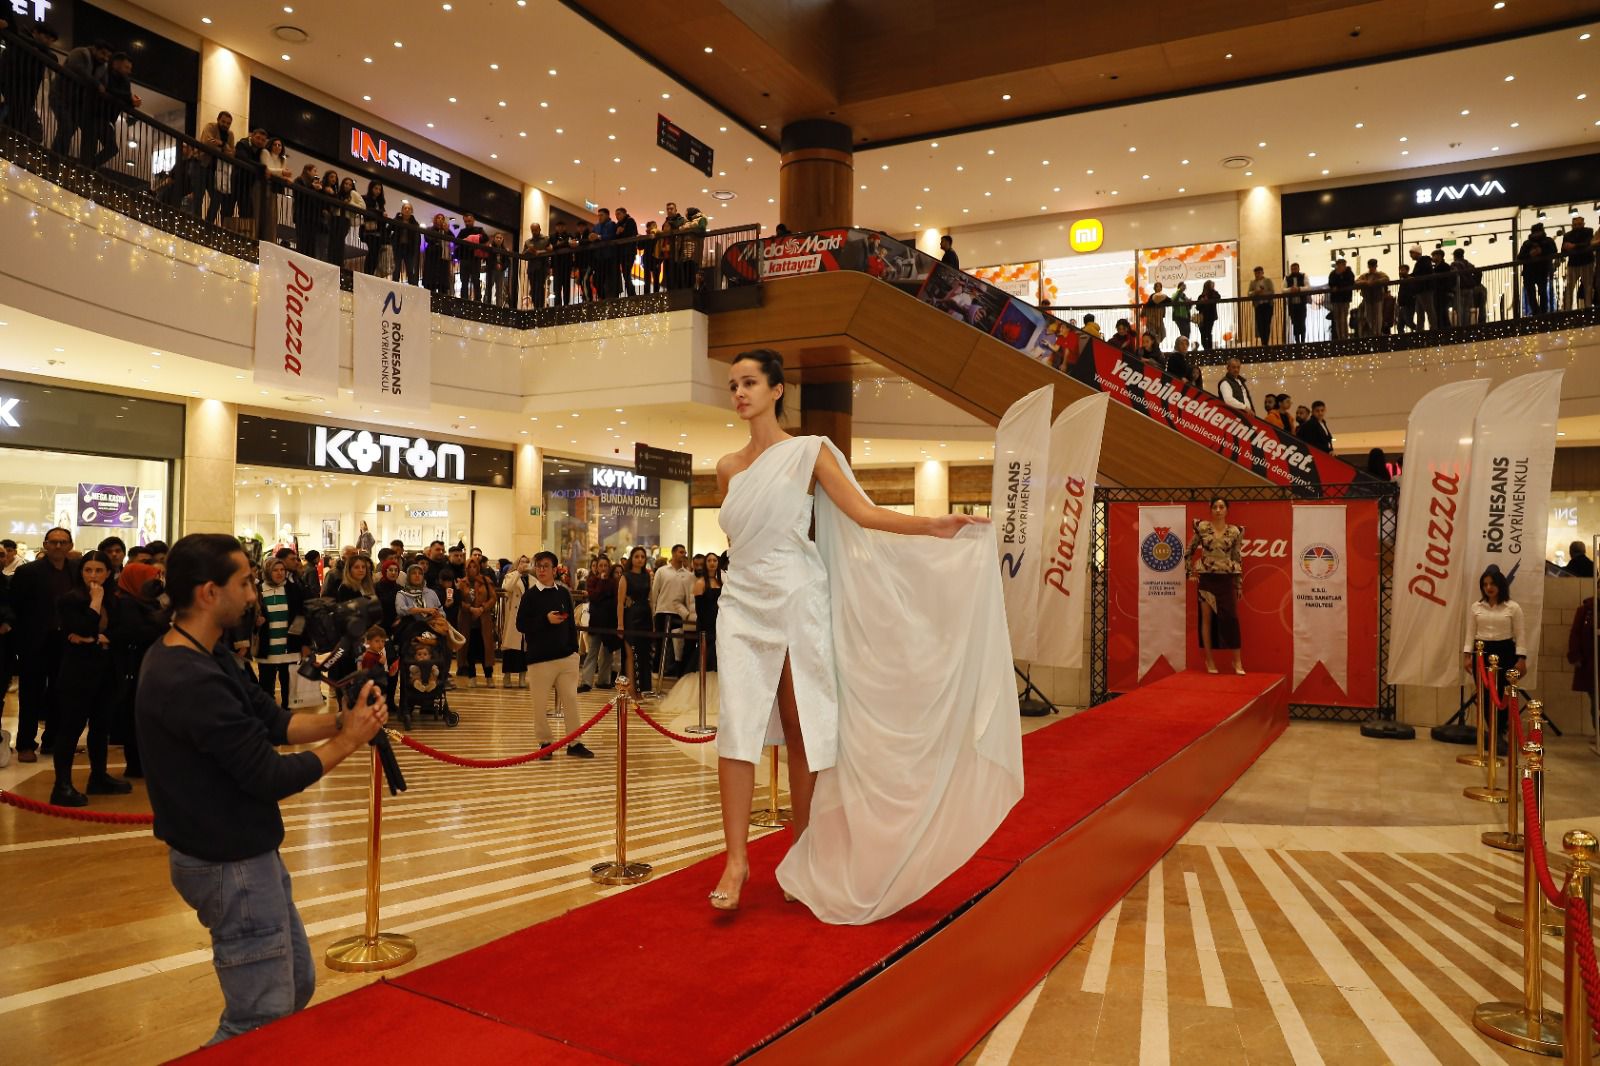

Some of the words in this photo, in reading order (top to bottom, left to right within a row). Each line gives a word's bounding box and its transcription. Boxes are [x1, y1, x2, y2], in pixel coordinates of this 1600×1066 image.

[1435, 180, 1506, 201] AVVA
[769, 257, 817, 273] kattayız!
[797, 234, 842, 254] Markt
[284, 260, 313, 376] Piazza
[381, 320, 390, 393] GAYRİMENKUL
[391, 322, 404, 395] RÖNESANS
[315, 426, 465, 480] KOTON
[1094, 374, 1119, 392] Yarının
[1120, 388, 1174, 419] teknolojileriyle
[1176, 416, 1242, 455] yapabileceklerini,
[1244, 450, 1271, 469] bugün
[1111, 360, 1257, 441] Yapabileceklerini
[1251, 430, 1313, 473] keşfet.
[592, 467, 647, 490] KOTON
[601, 493, 633, 505] BUNDAN
[635, 494, 658, 507] BÖYLE
[1002, 461, 1020, 544] RÖNESANS
[1018, 461, 1031, 545] GAYRİMENKUL
[1482, 456, 1510, 553] RÖNESANS
[1508, 457, 1529, 554] GAYRİMENKUL
[1044, 475, 1085, 597] Piazza
[1408, 471, 1460, 607] Piazza
[323, 647, 344, 669] RONIN
